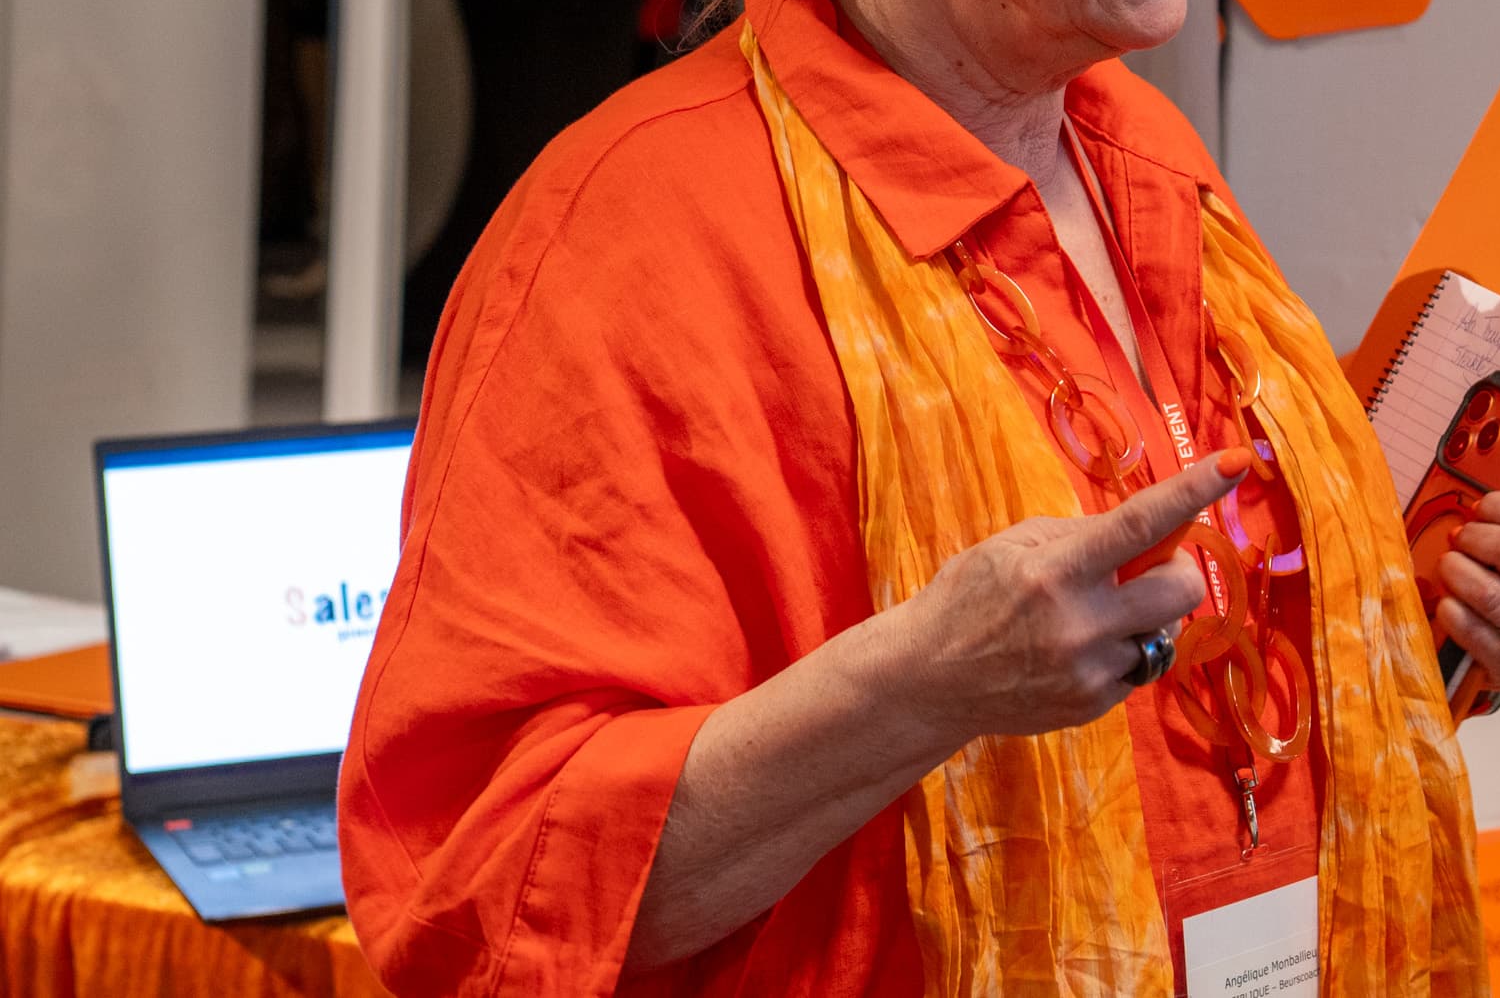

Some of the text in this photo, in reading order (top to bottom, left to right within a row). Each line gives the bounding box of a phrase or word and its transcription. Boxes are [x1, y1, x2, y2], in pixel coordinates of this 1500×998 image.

[1163, 402, 1194, 460] EVENT
[1224, 948, 1318, 990] Angélique Monballieu
